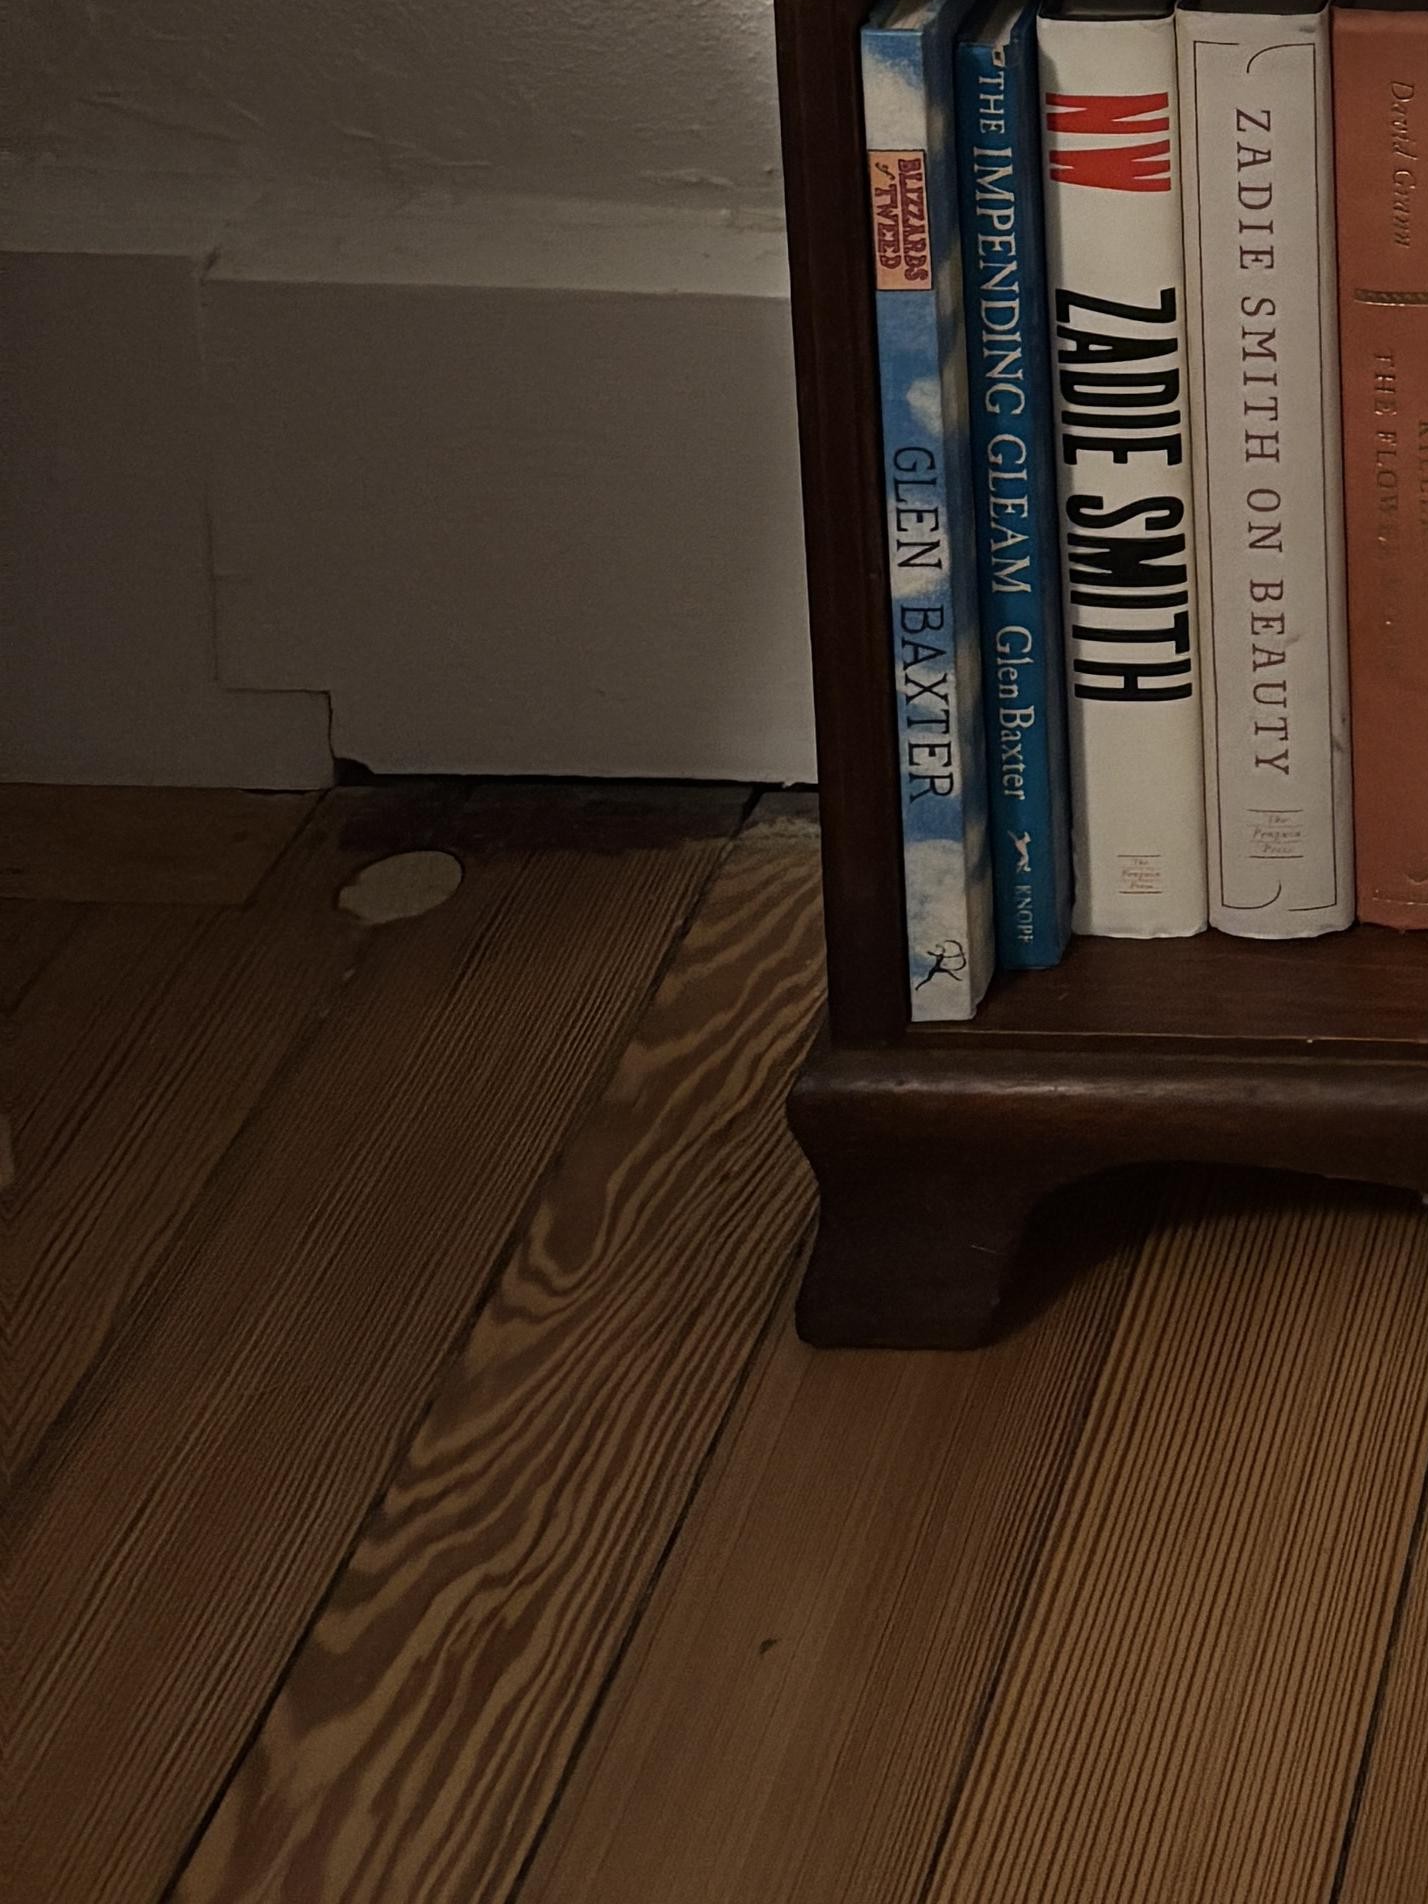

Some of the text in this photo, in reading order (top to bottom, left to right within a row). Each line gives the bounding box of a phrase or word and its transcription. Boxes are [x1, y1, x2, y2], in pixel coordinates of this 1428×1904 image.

[1045, 92, 1171, 192] NW
[972, 71, 1035, 800] THE IMPENDING GLEAM Glen Baxter
[1055, 288, 1193, 702] ZADIE SMITH
[1235, 109, 1290, 776] ZADIE SMITH ON BEAUTY
